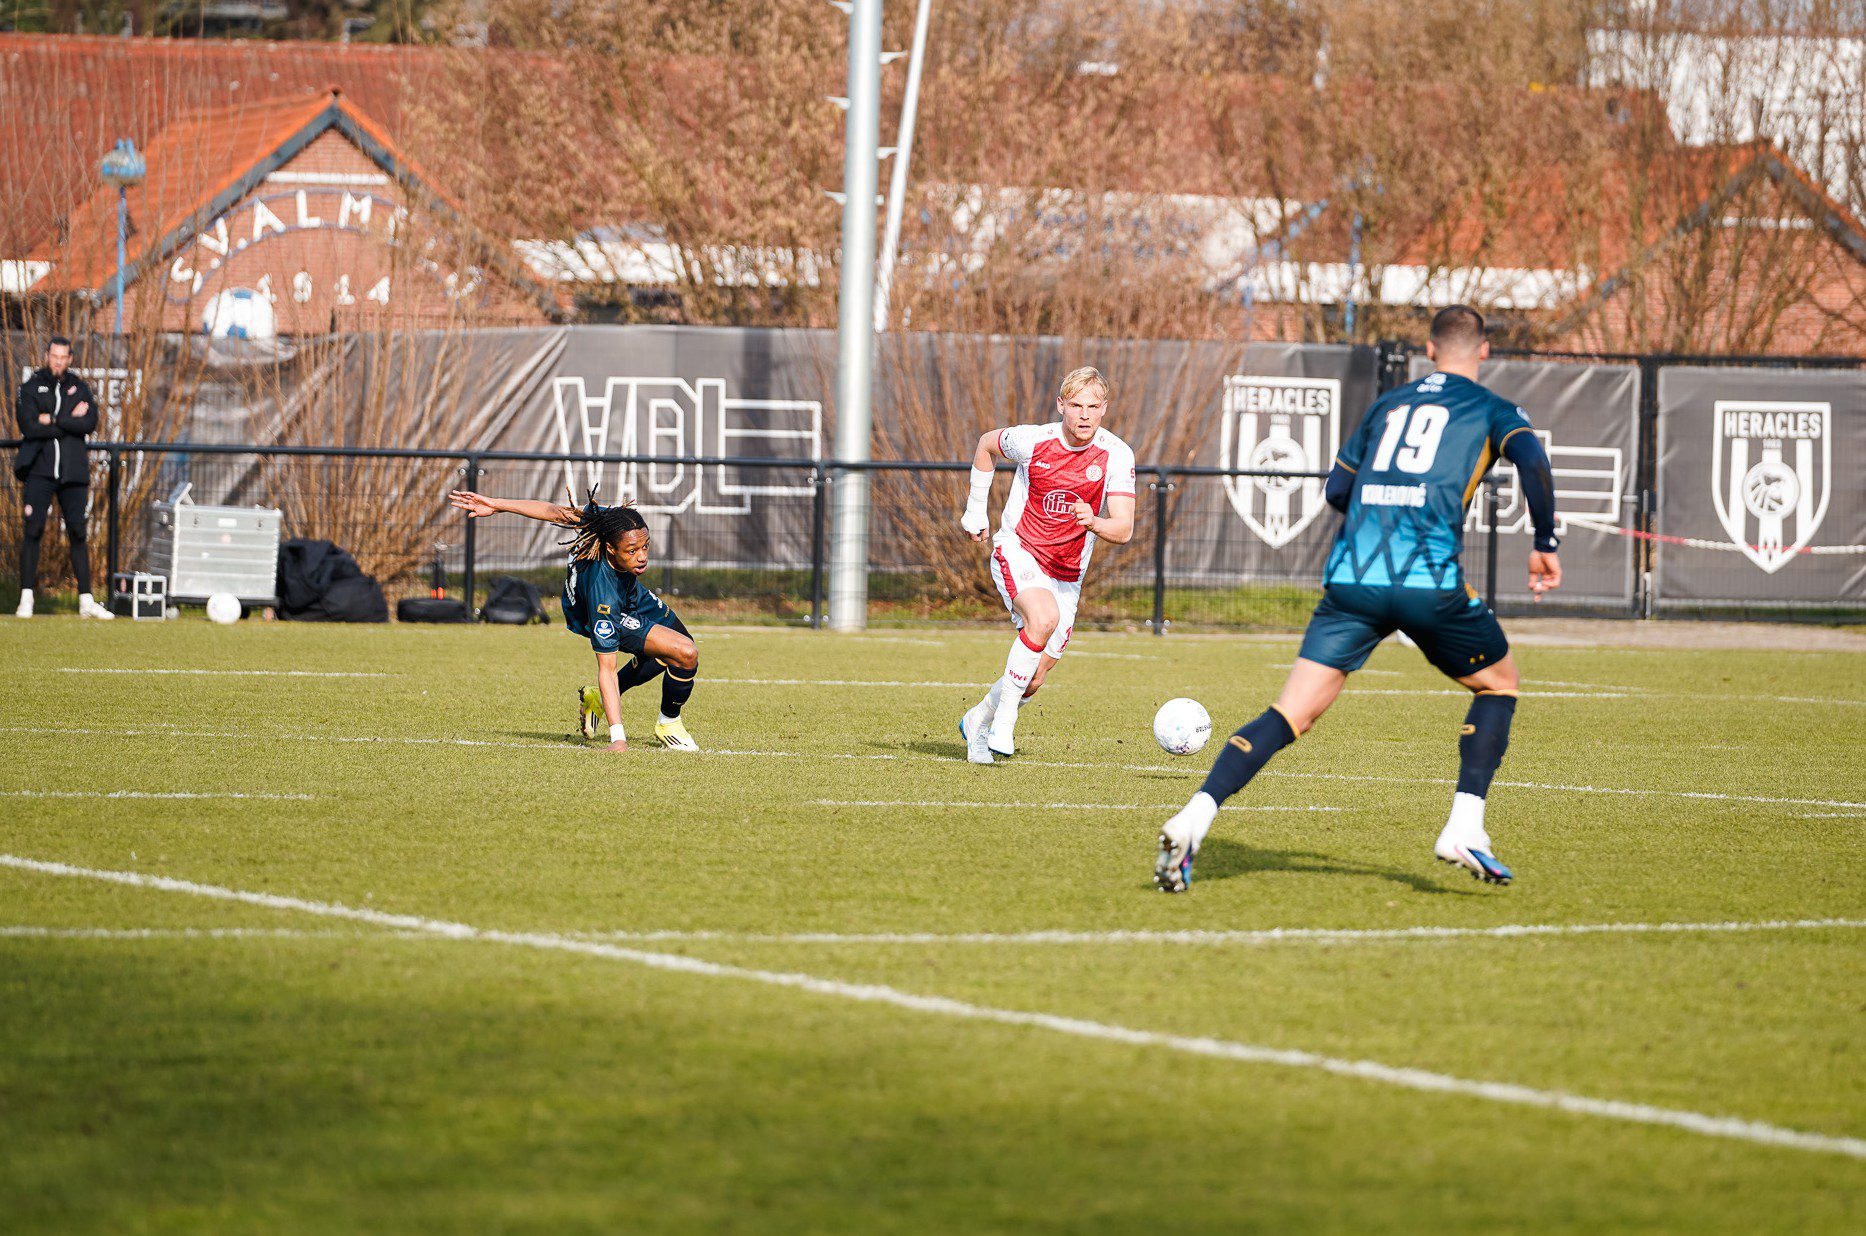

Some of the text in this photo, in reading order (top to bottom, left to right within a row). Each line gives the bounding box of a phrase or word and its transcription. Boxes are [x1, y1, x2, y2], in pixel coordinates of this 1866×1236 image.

[1233, 386, 1331, 416] HERACLES
[1371, 403, 1451, 475] 19
[1724, 411, 1822, 440] HERACLES
